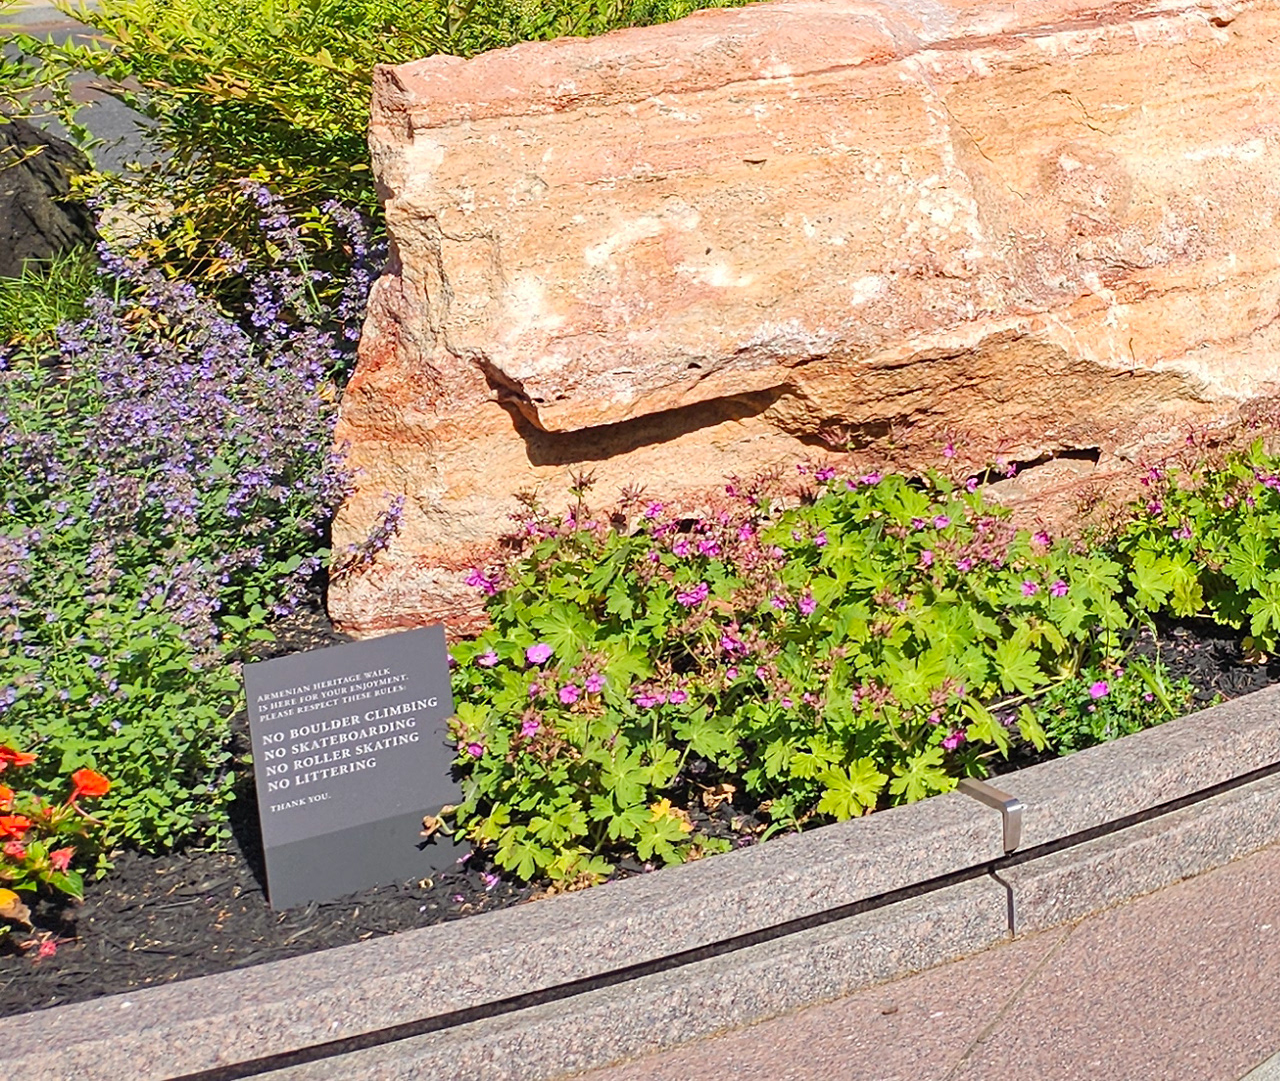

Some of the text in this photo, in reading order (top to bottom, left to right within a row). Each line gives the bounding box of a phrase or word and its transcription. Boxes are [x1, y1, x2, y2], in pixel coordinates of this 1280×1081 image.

[257, 667, 391, 703] ARMENIAN HERITAGE WALK
[258, 673, 409, 713] IS HERE FOR YOUR ENJOYMENT.
[259, 709, 295, 723] PLEASE
[297, 699, 339, 714] RESPECT
[342, 692, 372, 704] THESE
[262, 697, 438, 746] NO BOULDER CLIMBING
[264, 717, 417, 761] NO SKATEBOARDING
[266, 732, 420, 777] NO ROLLER SKATING
[267, 757, 377, 792] NO LITTERING
[270, 792, 332, 813] THANK YOU.
